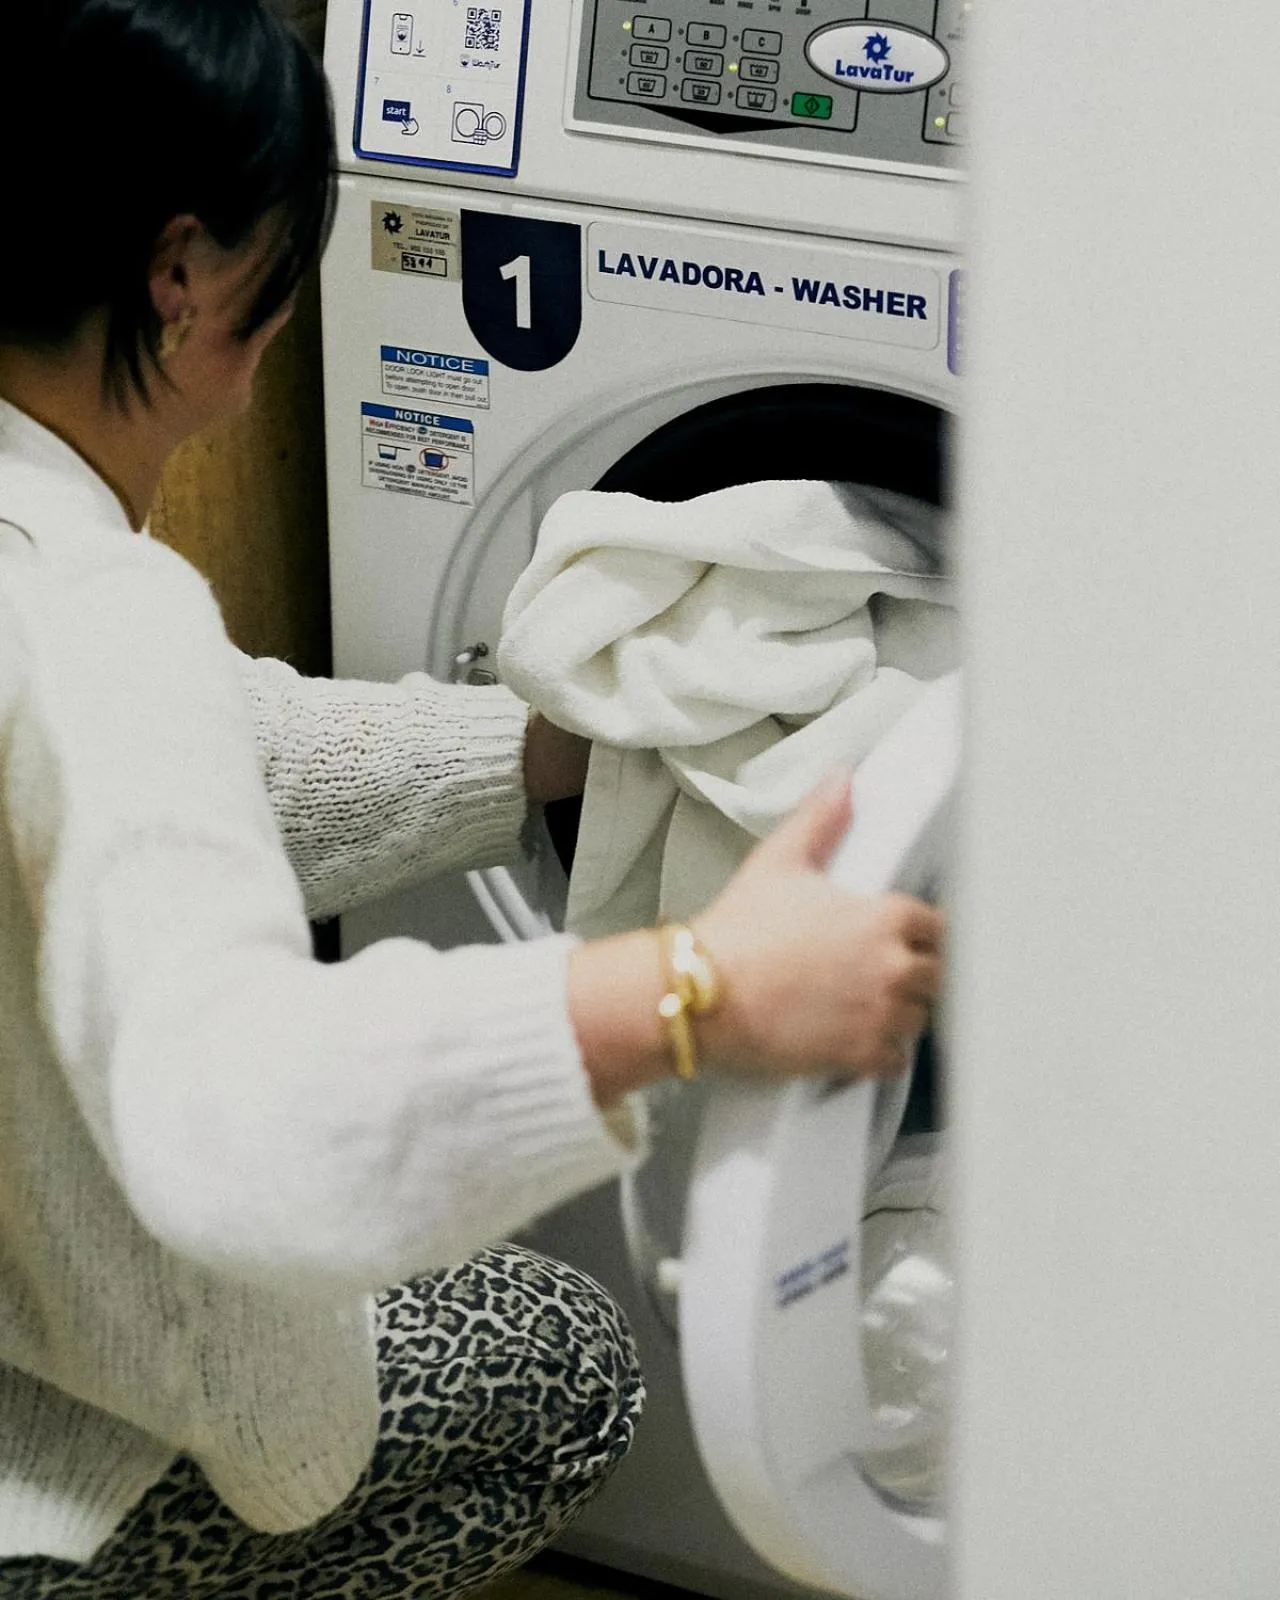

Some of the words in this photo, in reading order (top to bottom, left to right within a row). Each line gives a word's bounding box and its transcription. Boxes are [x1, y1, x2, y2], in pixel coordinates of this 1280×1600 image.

[648, 23, 655, 34] A
[703, 30, 710, 41] B
[758, 36, 765, 47] C
[835, 59, 914, 83] LavaTur
[386, 106, 408, 117] start
[415, 228, 450, 240] LAVATUR
[598, 249, 766, 296] LAVADORA
[792, 277, 928, 320] WASHER
[499, 255, 531, 329] 1
[396, 350, 475, 372] NOTICE
[385, 364, 404, 372] DOOR
[407, 367, 424, 375] LOCK
[394, 410, 441, 426] NOTICE
